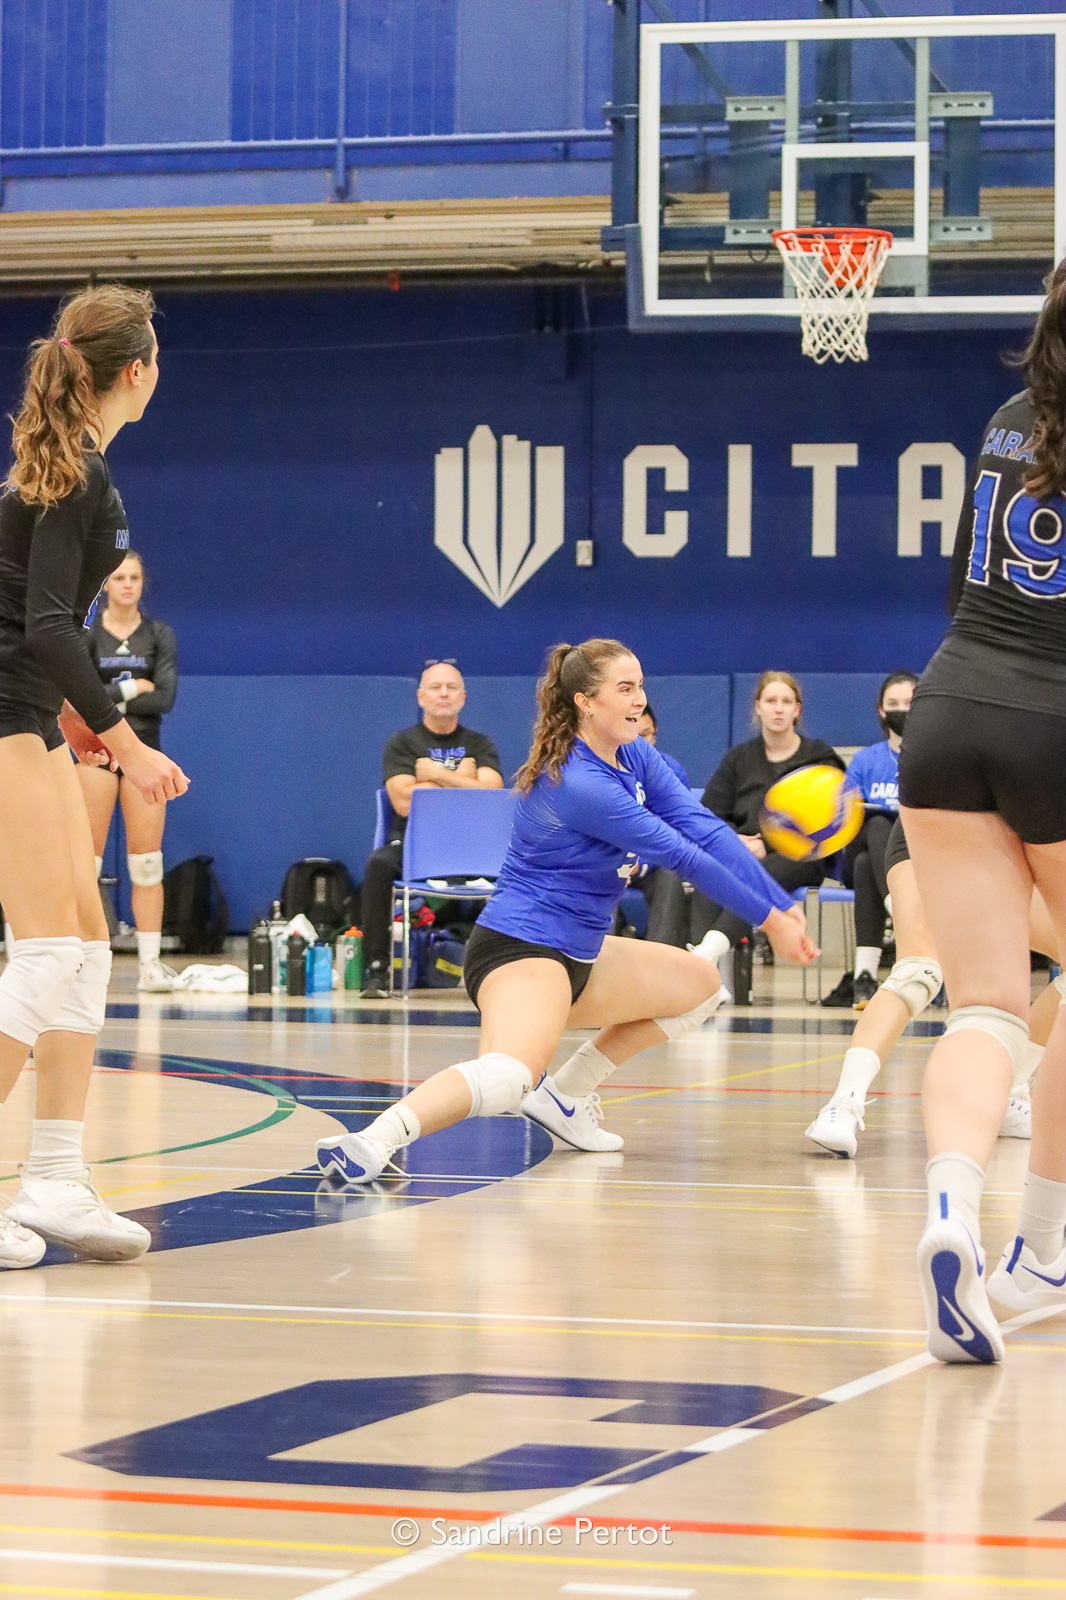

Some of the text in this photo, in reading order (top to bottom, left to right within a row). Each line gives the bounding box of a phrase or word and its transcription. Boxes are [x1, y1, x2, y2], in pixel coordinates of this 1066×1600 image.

[622, 442, 966, 557] CITA
[980, 427, 1037, 463] CARA
[966, 469, 1066, 599] 19
